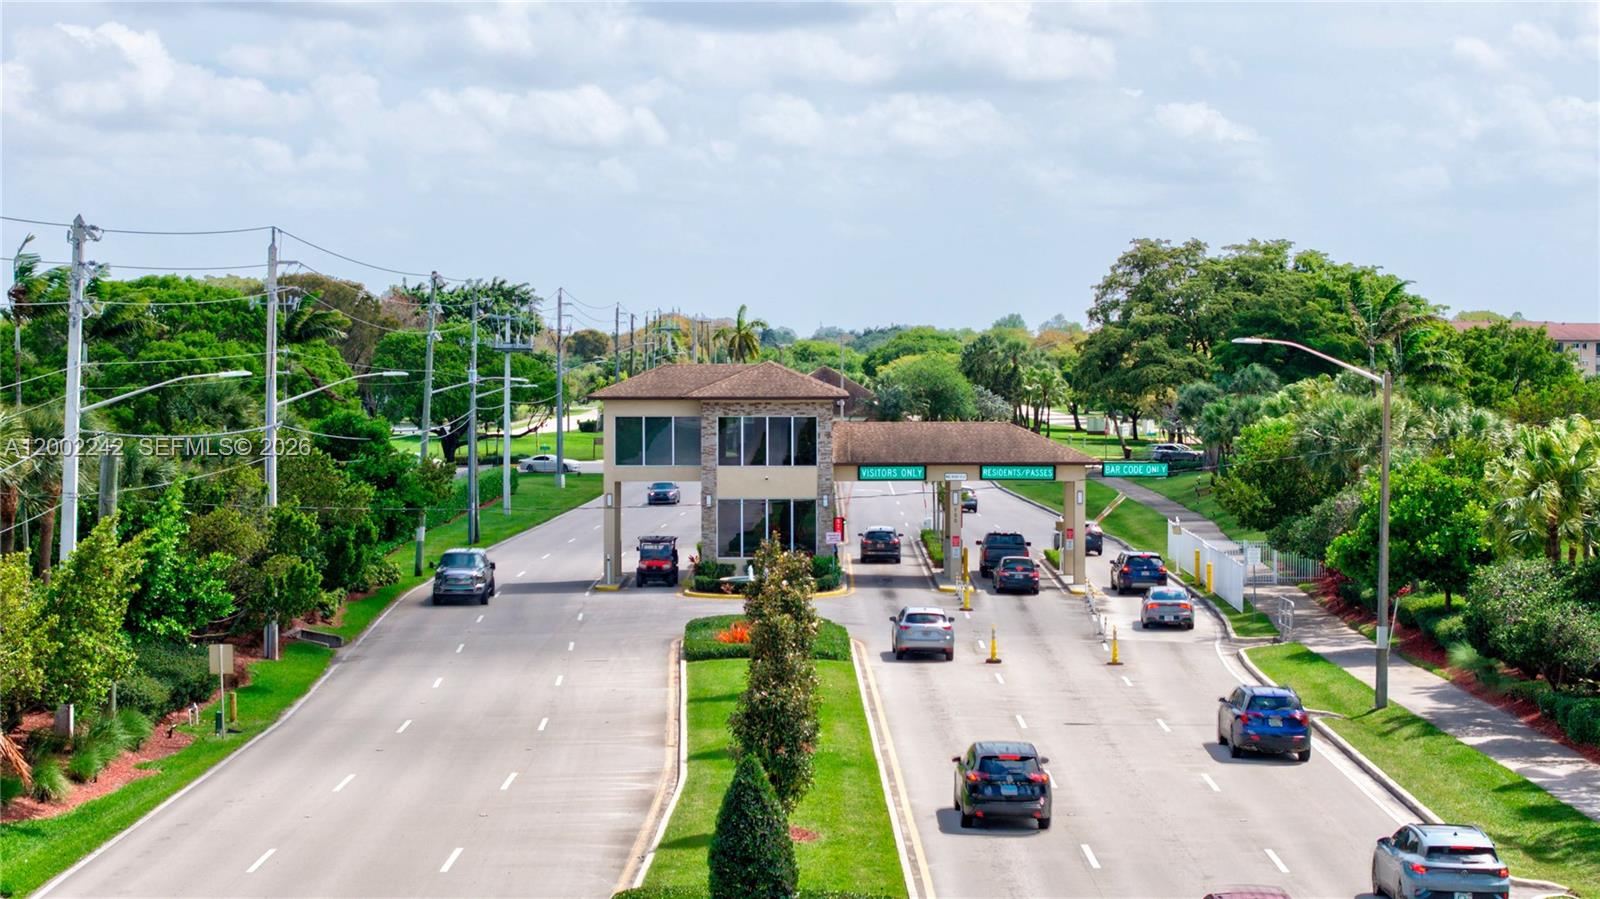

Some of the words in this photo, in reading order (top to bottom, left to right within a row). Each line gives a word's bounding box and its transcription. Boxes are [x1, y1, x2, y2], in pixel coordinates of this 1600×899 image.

[861, 468, 898, 478] VISITORS
[900, 468, 922, 478] ONLY
[982, 468, 1053, 477] RESIDENTS/PASSES
[1105, 465, 1120, 474] BAR
[1123, 465, 1143, 474] CODE
